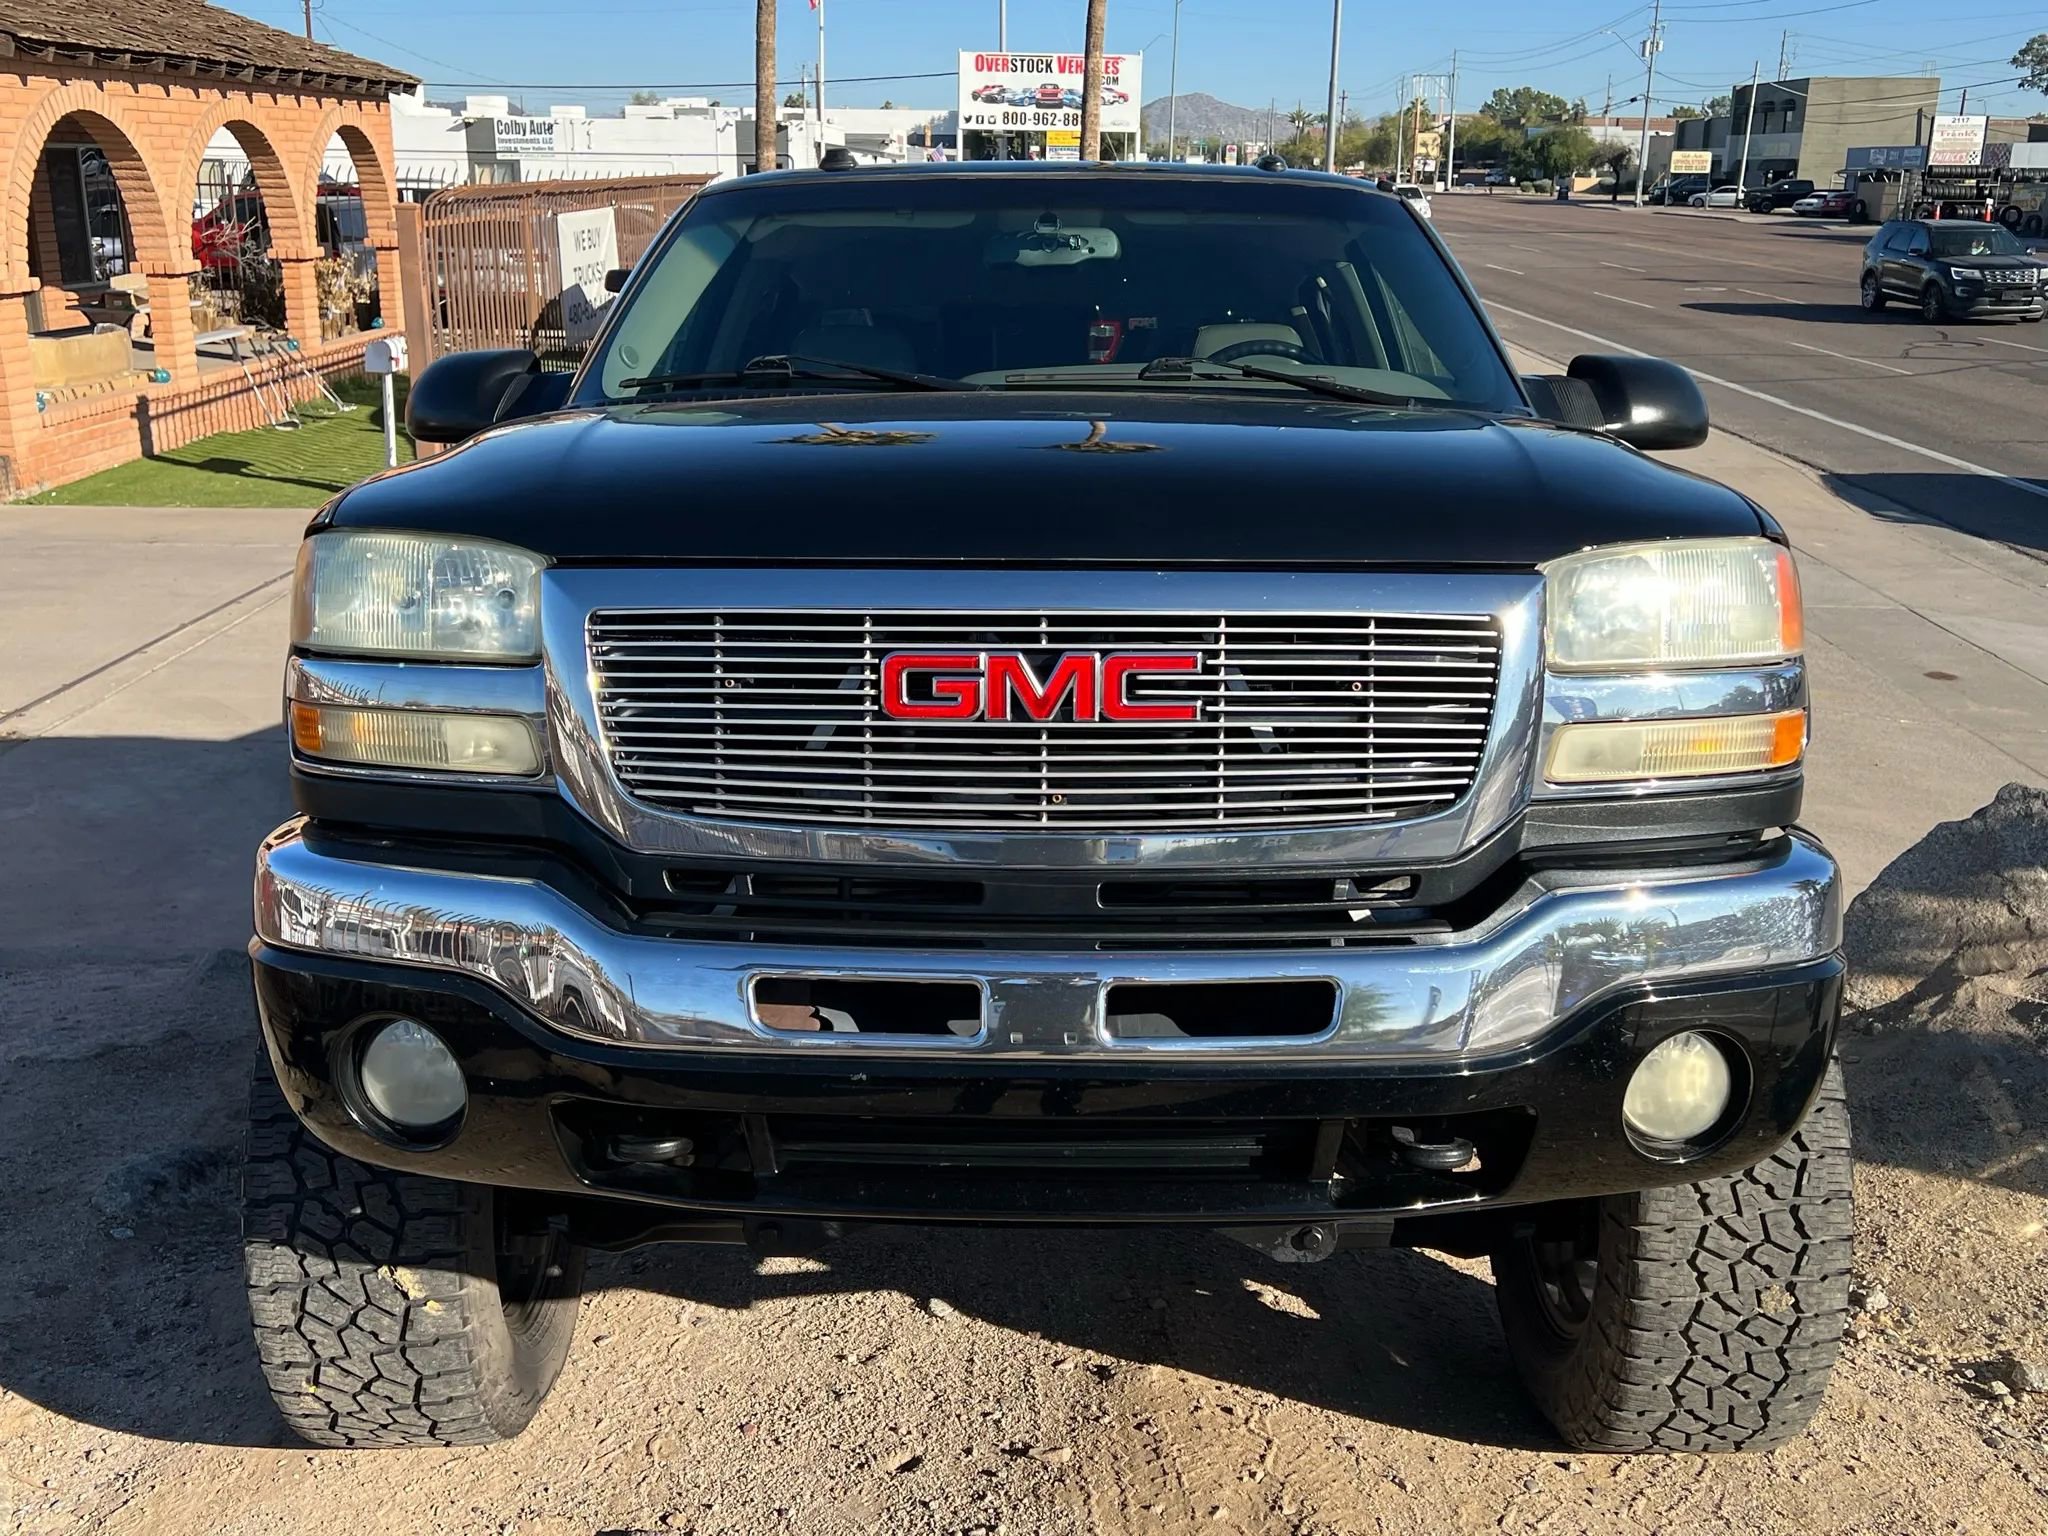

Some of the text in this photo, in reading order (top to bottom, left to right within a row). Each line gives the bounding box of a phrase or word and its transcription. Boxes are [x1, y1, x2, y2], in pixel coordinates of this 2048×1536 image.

[975, 53, 1120, 76] OVERSTOCK VEHES
[496, 119, 554, 136] Colby Auto
[1002, 111, 1082, 127] 800-962-88
[573, 226, 602, 253] WE BUY
[881, 650, 1203, 722] GMC
